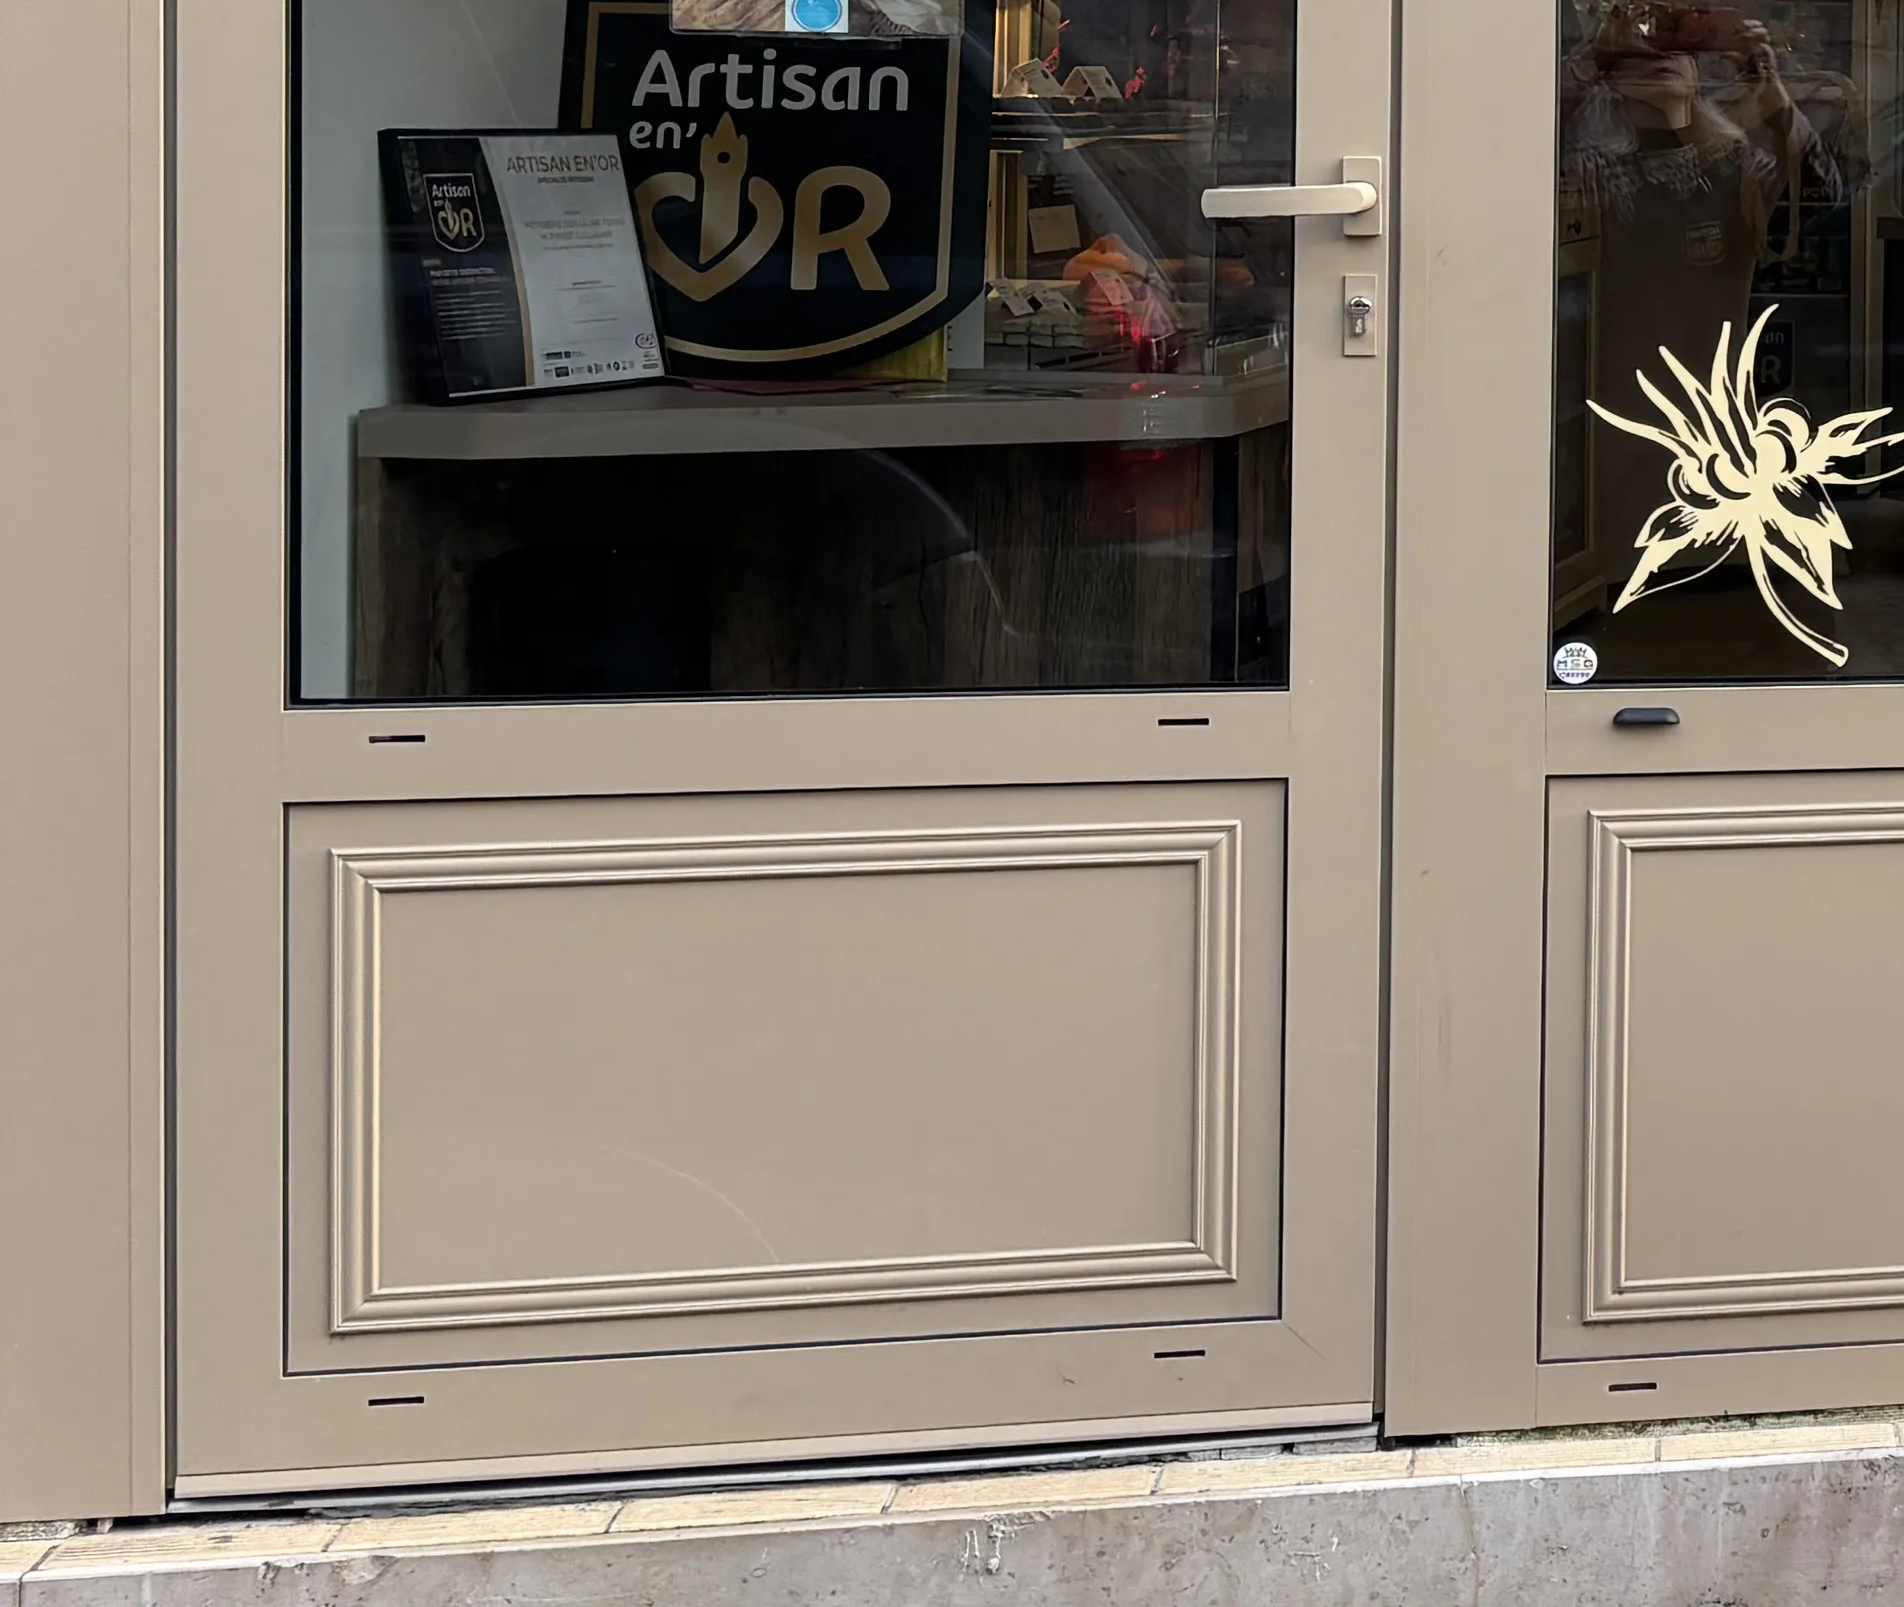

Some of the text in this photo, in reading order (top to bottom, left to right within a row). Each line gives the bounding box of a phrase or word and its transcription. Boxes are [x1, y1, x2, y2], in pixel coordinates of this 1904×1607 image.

[631, 48, 910, 111] Artisan
[506, 154, 621, 173] ARTISAN EN'OR
[432, 182, 471, 198] Artisan
